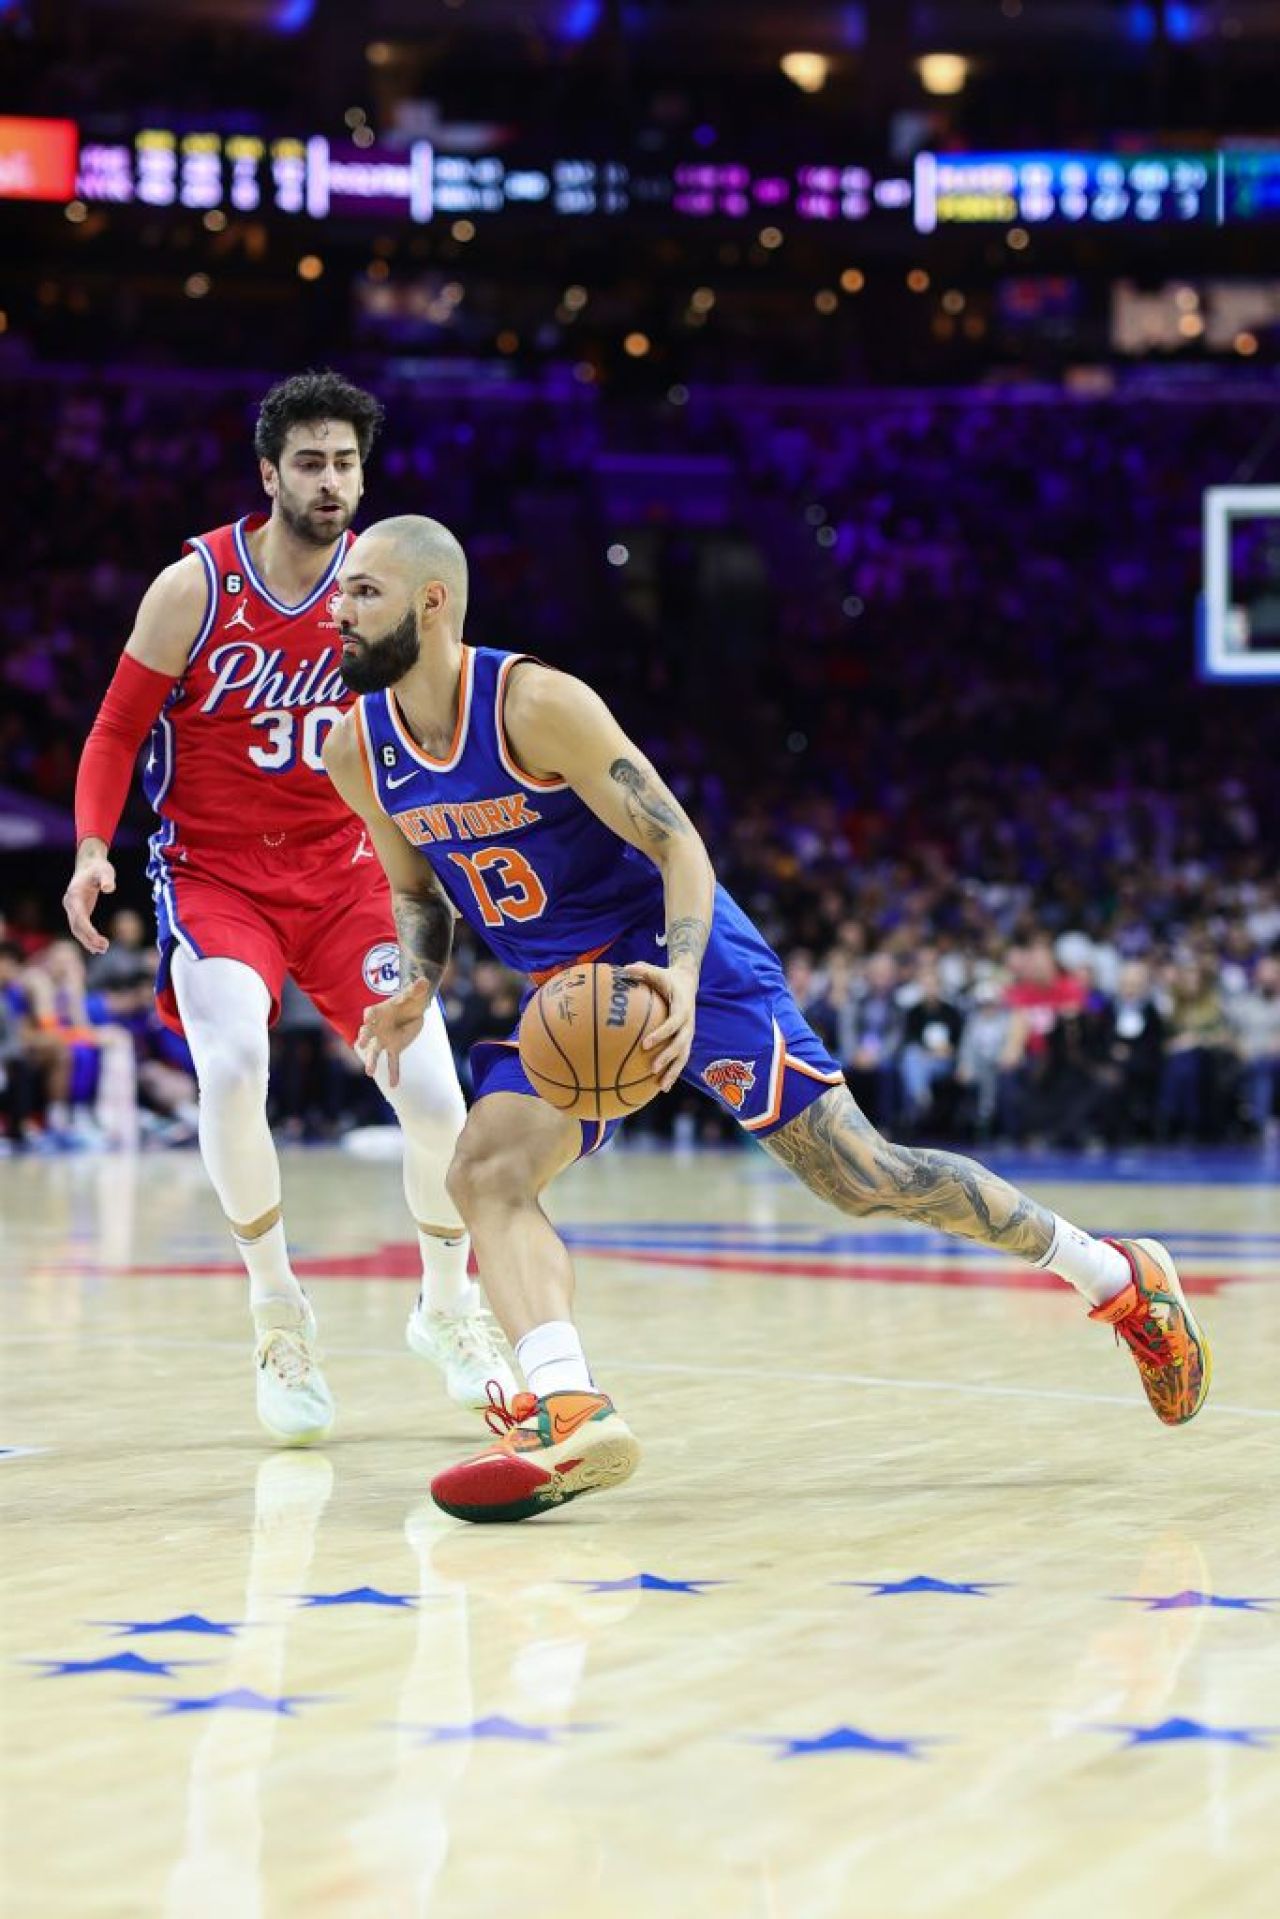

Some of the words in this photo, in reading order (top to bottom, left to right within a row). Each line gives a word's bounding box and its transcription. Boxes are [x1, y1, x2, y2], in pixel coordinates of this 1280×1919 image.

[226, 574, 241, 593] 6
[201, 640, 347, 713] Phila
[248, 705, 346, 775] 30
[383, 746, 397, 767] 6
[448, 846, 547, 926] 13
